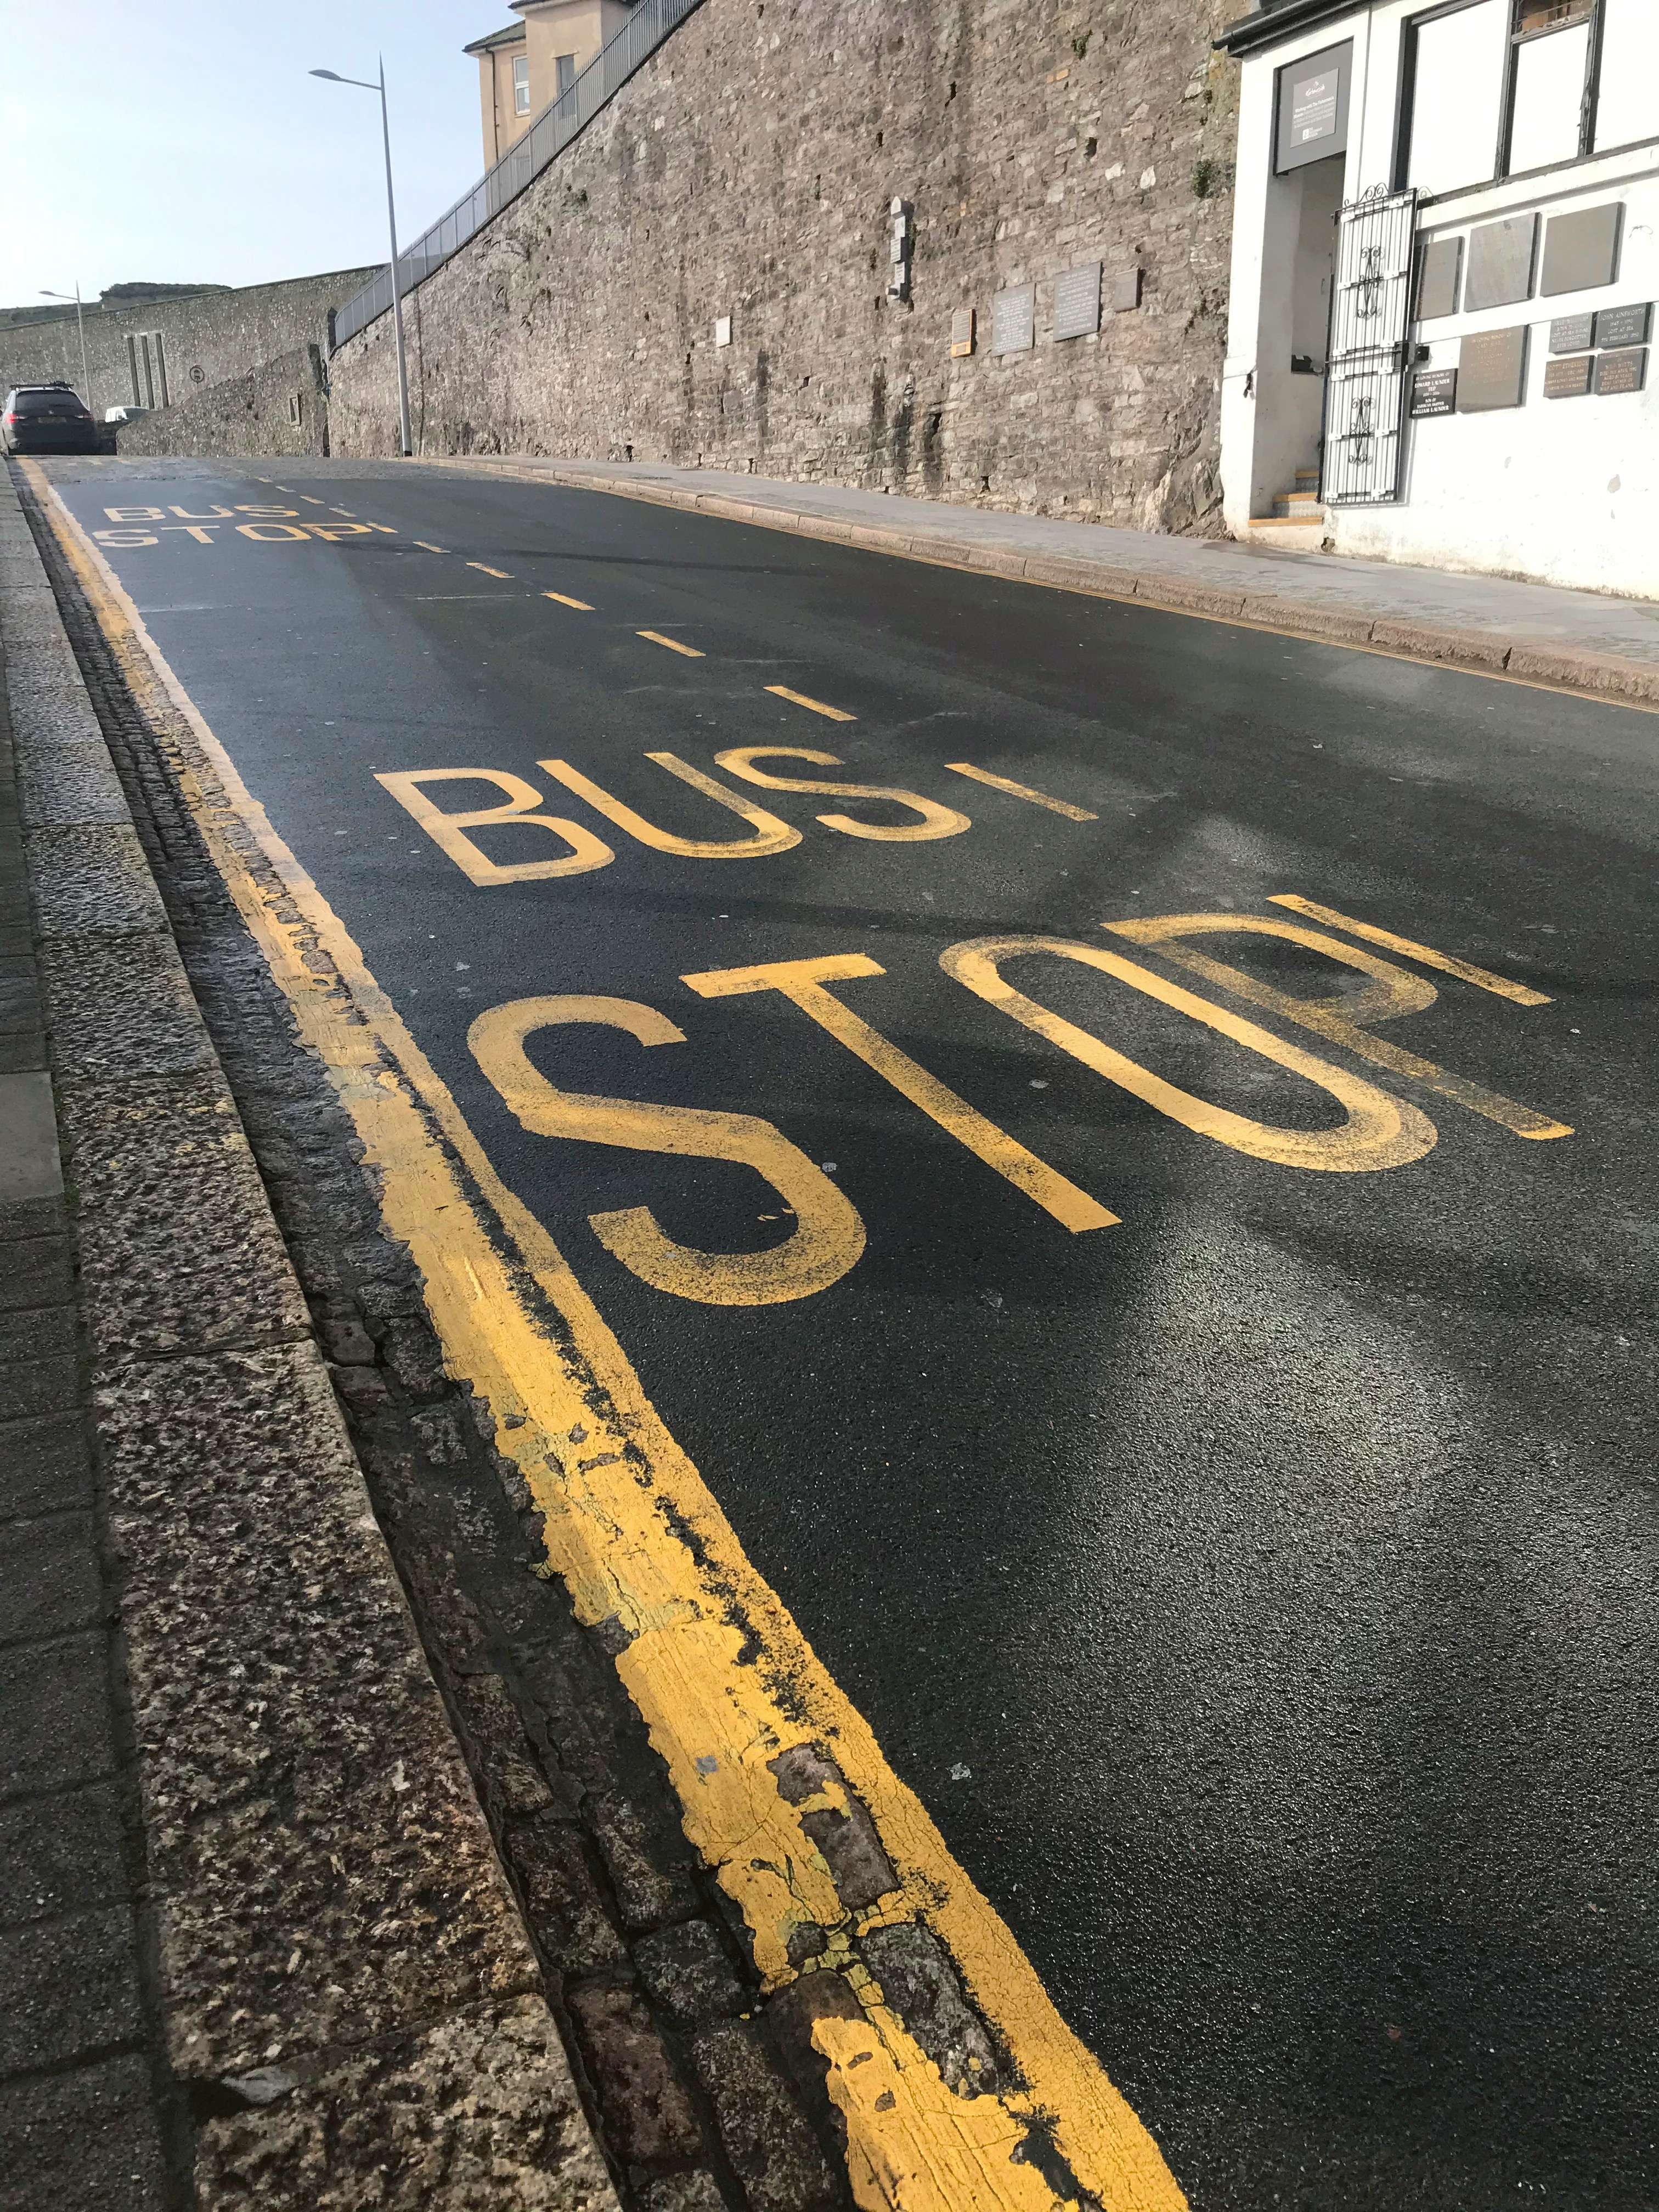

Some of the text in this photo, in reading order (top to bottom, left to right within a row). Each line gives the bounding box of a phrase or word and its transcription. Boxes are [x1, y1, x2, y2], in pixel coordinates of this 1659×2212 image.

[1616, 308, 1645, 318] AINSWORTH
[103, 505, 300, 522] BUS
[92, 523, 373, 547] STOP
[374, 746, 972, 887] BUS
[466, 912, 1576, 1306] STOP
